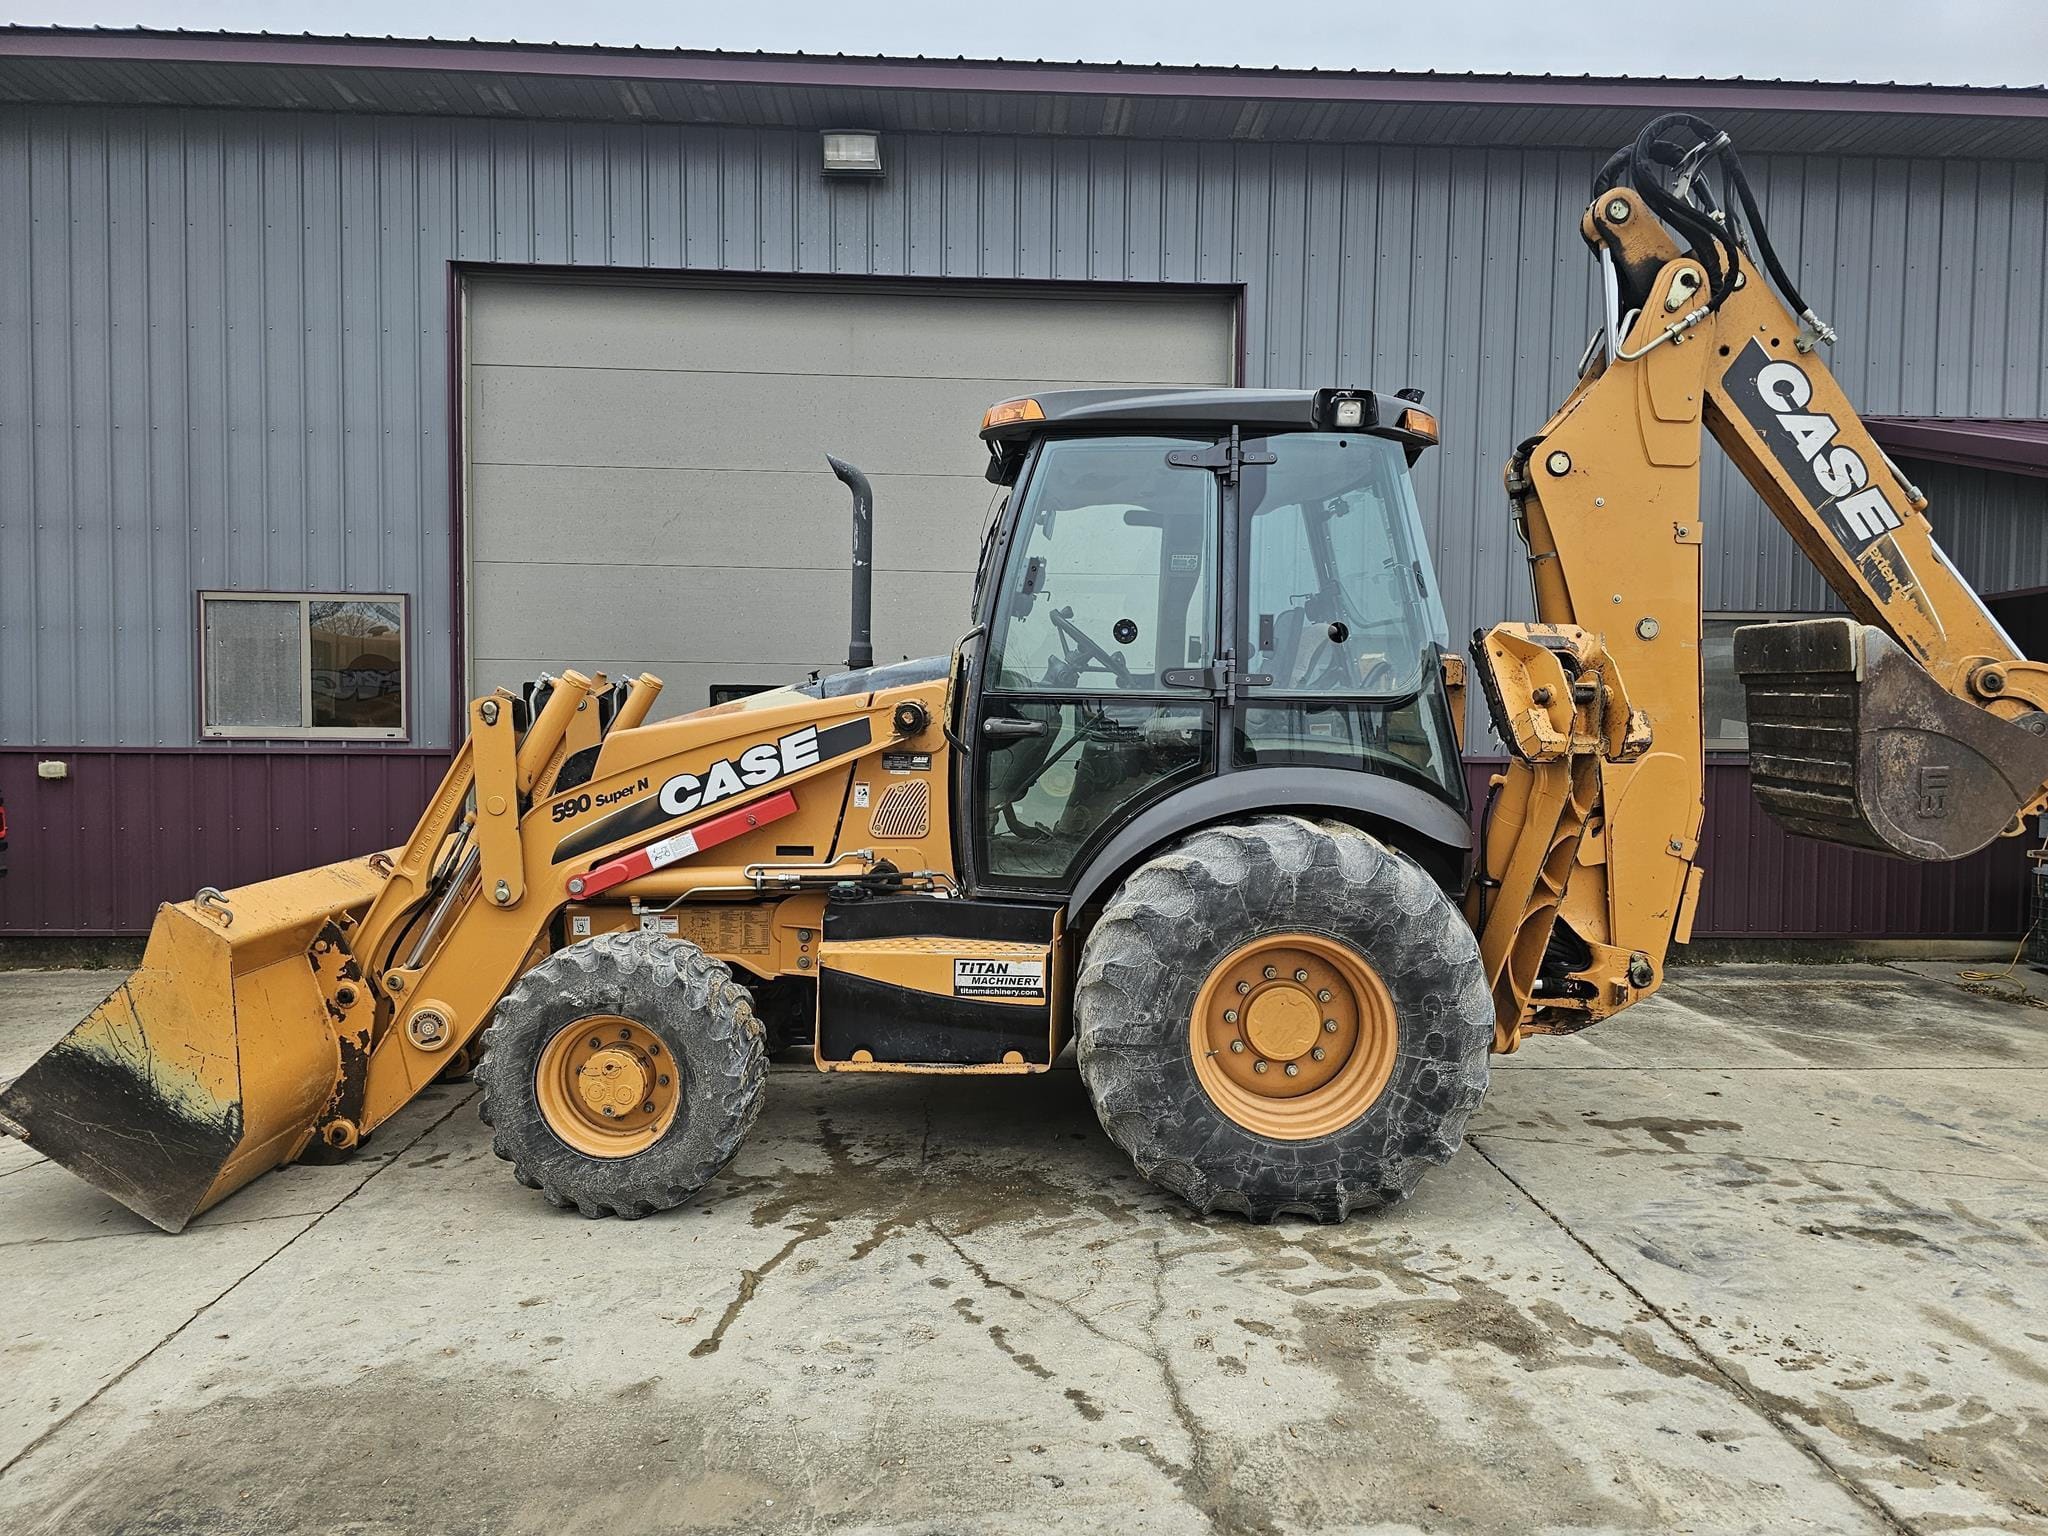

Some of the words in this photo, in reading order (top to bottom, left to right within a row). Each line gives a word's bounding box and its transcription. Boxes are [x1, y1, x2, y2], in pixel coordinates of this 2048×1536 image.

[1757, 362, 1902, 542] CASE
[659, 725, 820, 816] CASE
[552, 793, 592, 823] 590
[595, 783, 635, 807] Super
[637, 776, 649, 792] N
[959, 962, 1009, 974] TITAN
[971, 976, 1040, 986] MACHINERY
[960, 987, 1038, 997] titanmachinery.com
[418, 1013, 443, 1028] CONTROL
